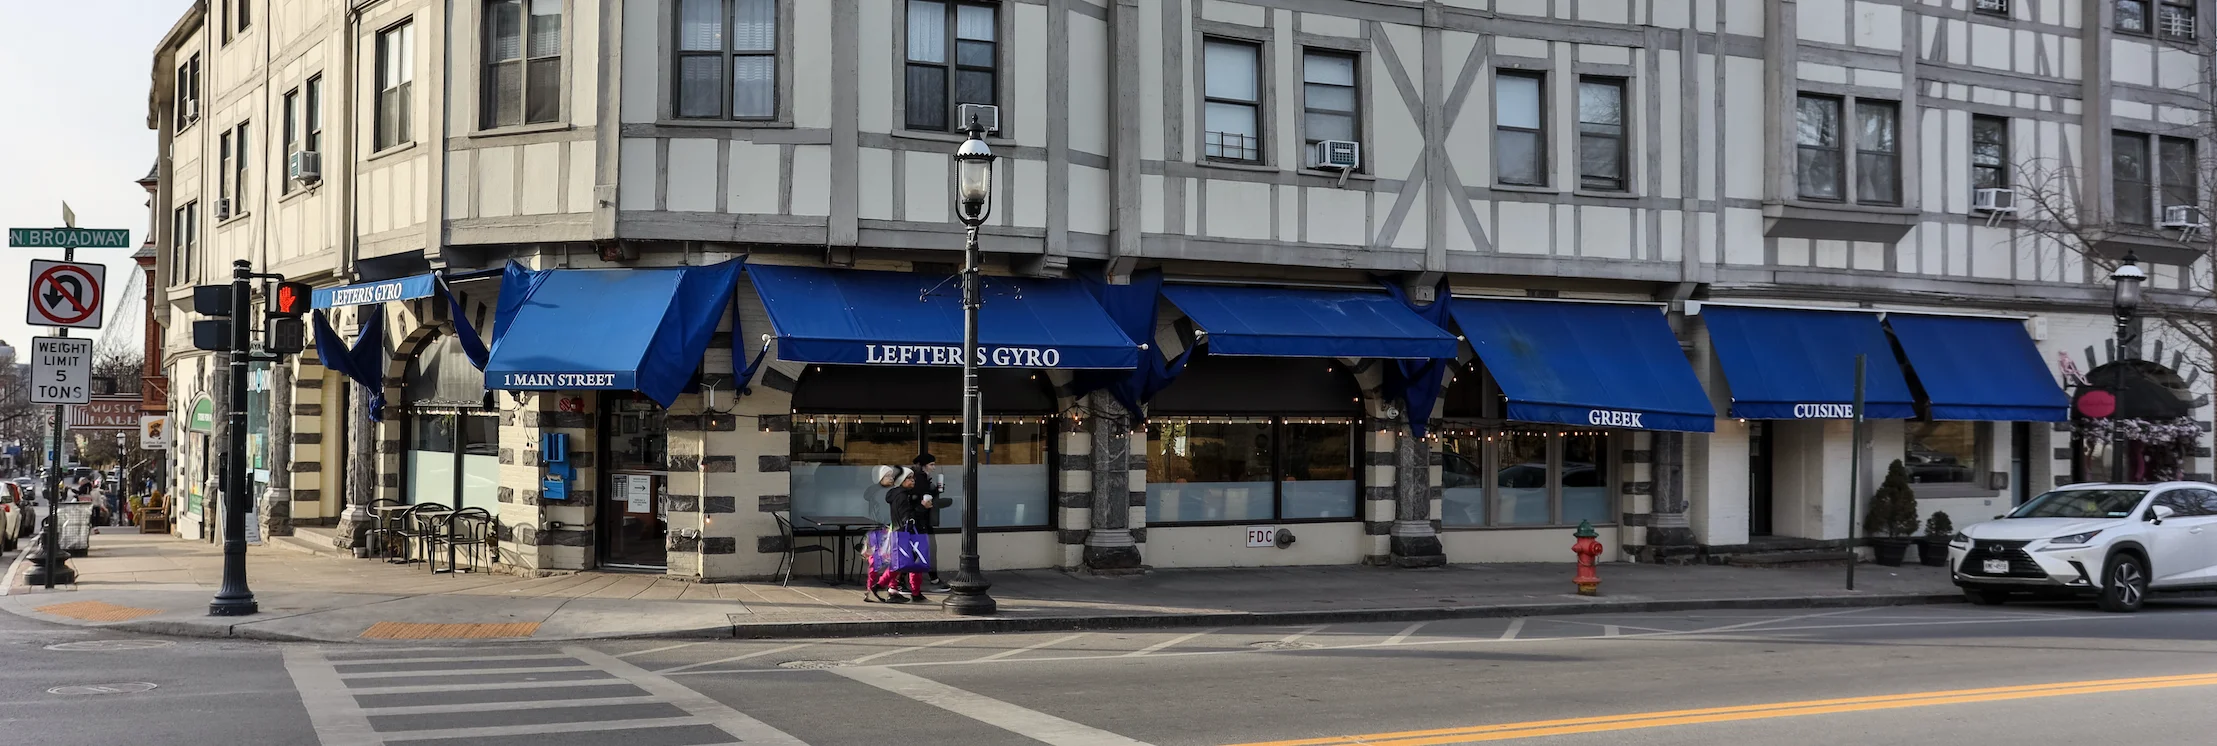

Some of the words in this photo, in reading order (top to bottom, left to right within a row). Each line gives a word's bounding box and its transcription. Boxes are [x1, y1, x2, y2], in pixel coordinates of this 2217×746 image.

[30, 230, 127, 246] BROADWAY
[331, 286, 374, 306] LEFTERIS
[374, 282, 402, 302] GYRO
[39, 342, 87, 354] WEIGHT
[44, 355, 79, 366] LIMIT
[866, 344, 987, 365] LEFTERS
[992, 347, 1060, 367] GYRO
[56, 370, 67, 382] 5
[504, 374, 511, 386] 1
[514, 374, 555, 386] MAIN
[557, 373, 615, 386] STREET
[38, 385, 82, 399] TONS
[91, 403, 136, 414] MUSIC
[1793, 403, 1854, 418] CUISINE
[90, 415, 138, 425] HALL
[1588, 409, 1644, 428] GREEK
[1248, 530, 1272, 543] FDC
